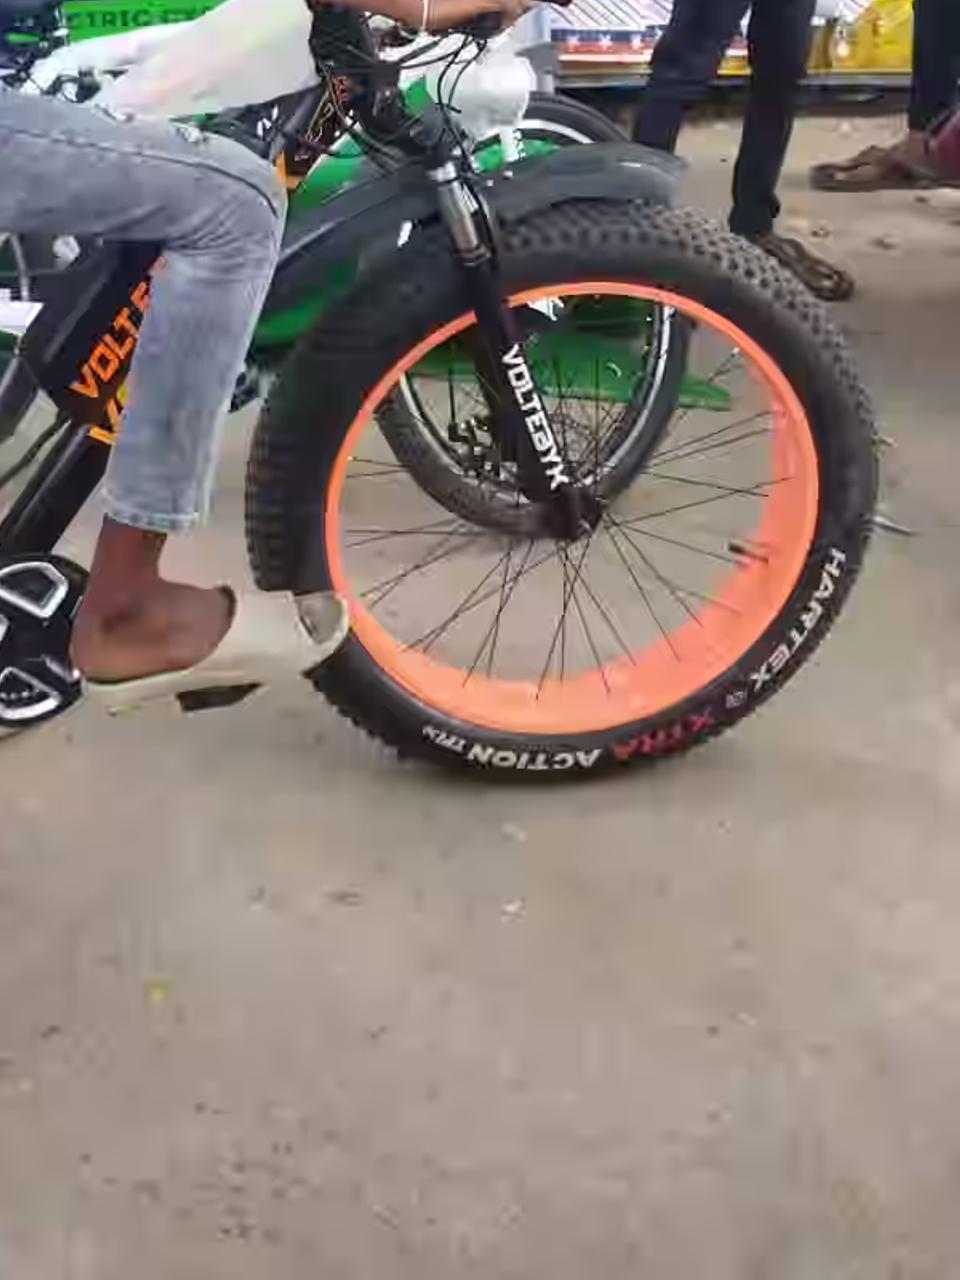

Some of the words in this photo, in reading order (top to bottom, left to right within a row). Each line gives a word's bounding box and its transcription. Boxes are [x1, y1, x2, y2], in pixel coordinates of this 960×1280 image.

[502, 344, 569, 490] VOLTEBYK
[752, 548, 846, 690] HARTEX
[467, 744, 603, 770] ACTION
